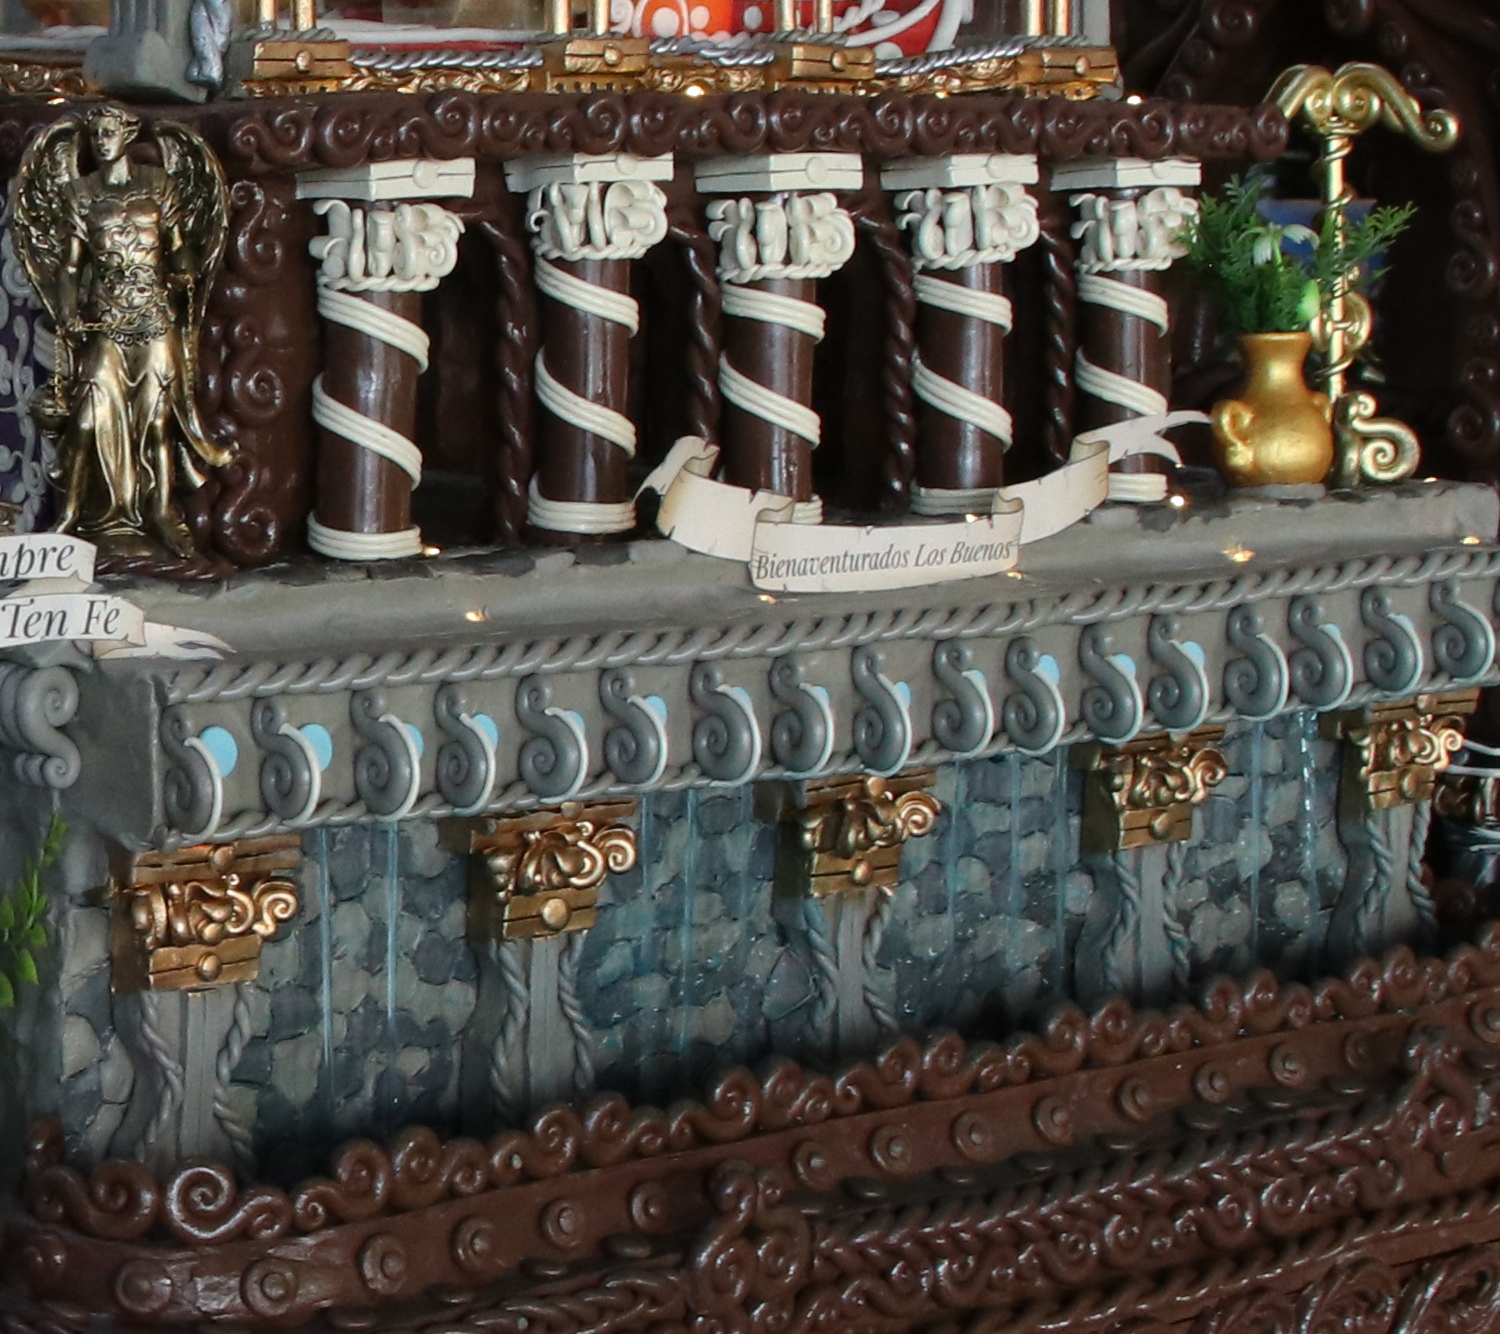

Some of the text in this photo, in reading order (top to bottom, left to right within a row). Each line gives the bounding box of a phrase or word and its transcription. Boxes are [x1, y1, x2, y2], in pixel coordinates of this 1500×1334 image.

[755, 539, 1011, 580] Bienaventurados Los Buenos
[1, 599, 121, 639] Ten Fe
